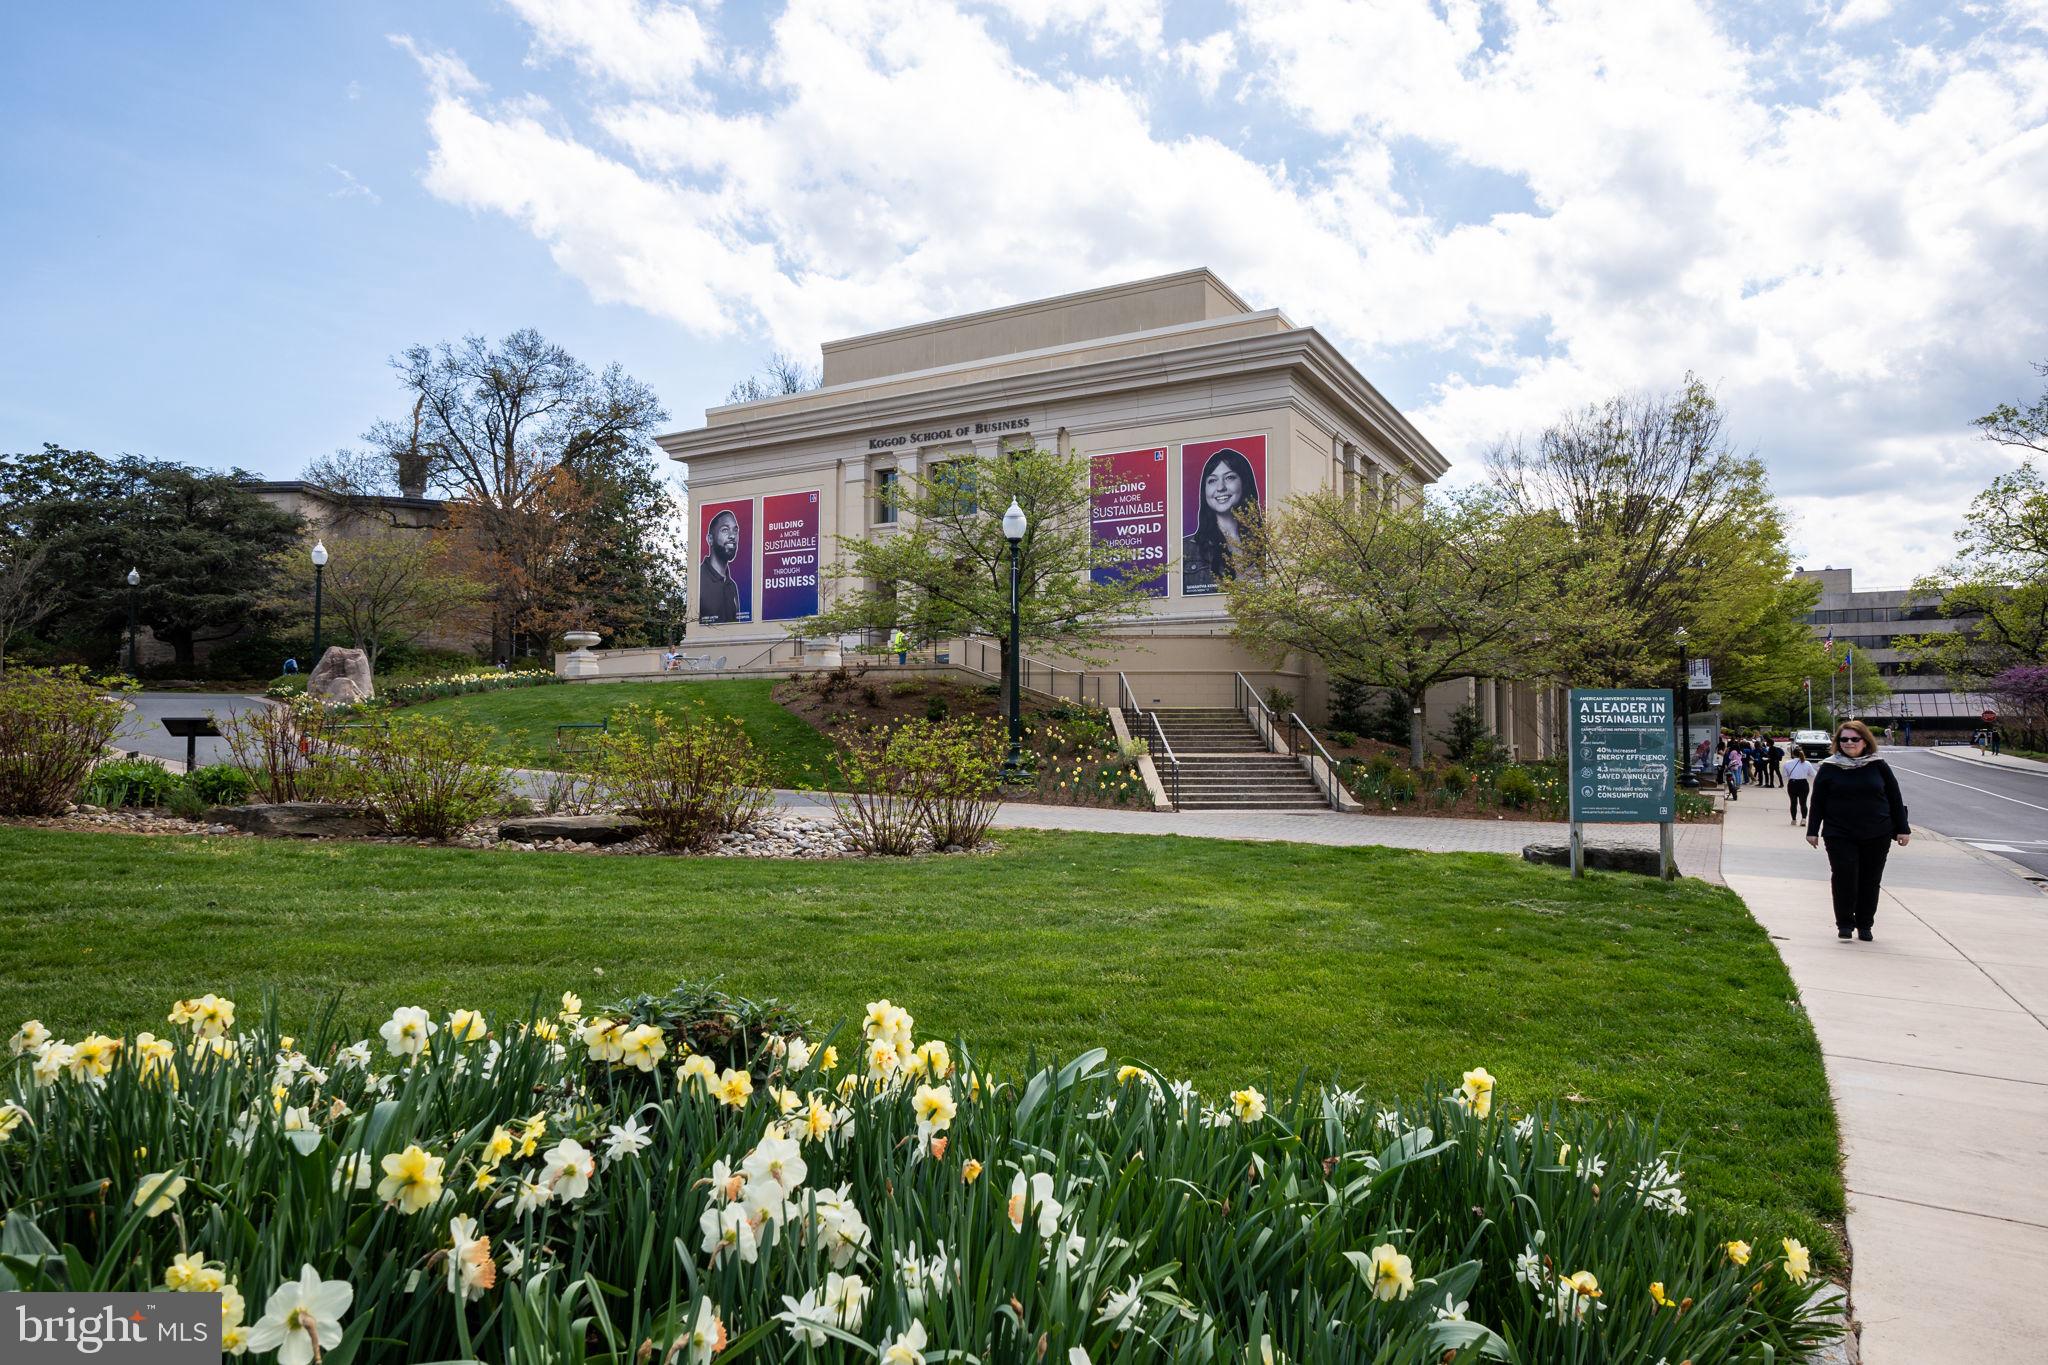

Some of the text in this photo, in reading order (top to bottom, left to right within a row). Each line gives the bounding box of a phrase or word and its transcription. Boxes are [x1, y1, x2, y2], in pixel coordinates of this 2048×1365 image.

[868, 418, 1030, 450] KOGOD SCHOOL OF BUSINESS
[1098, 481, 1147, 495] UILDING
[1120, 494, 1141, 503] MORE
[1092, 501, 1164, 519] SUSTAINABLE
[768, 519, 805, 531] BUILDING
[1116, 522, 1162, 536] WORLD
[764, 536, 817, 551] SUSTAINABLE
[781, 554, 815, 566] WORLD
[773, 567, 801, 576] THROUGH
[765, 574, 816, 589] BUSINESS
[1580, 702, 1665, 713] A LEADER IN
[1580, 715, 1666, 724] SUSTAINABILITY
